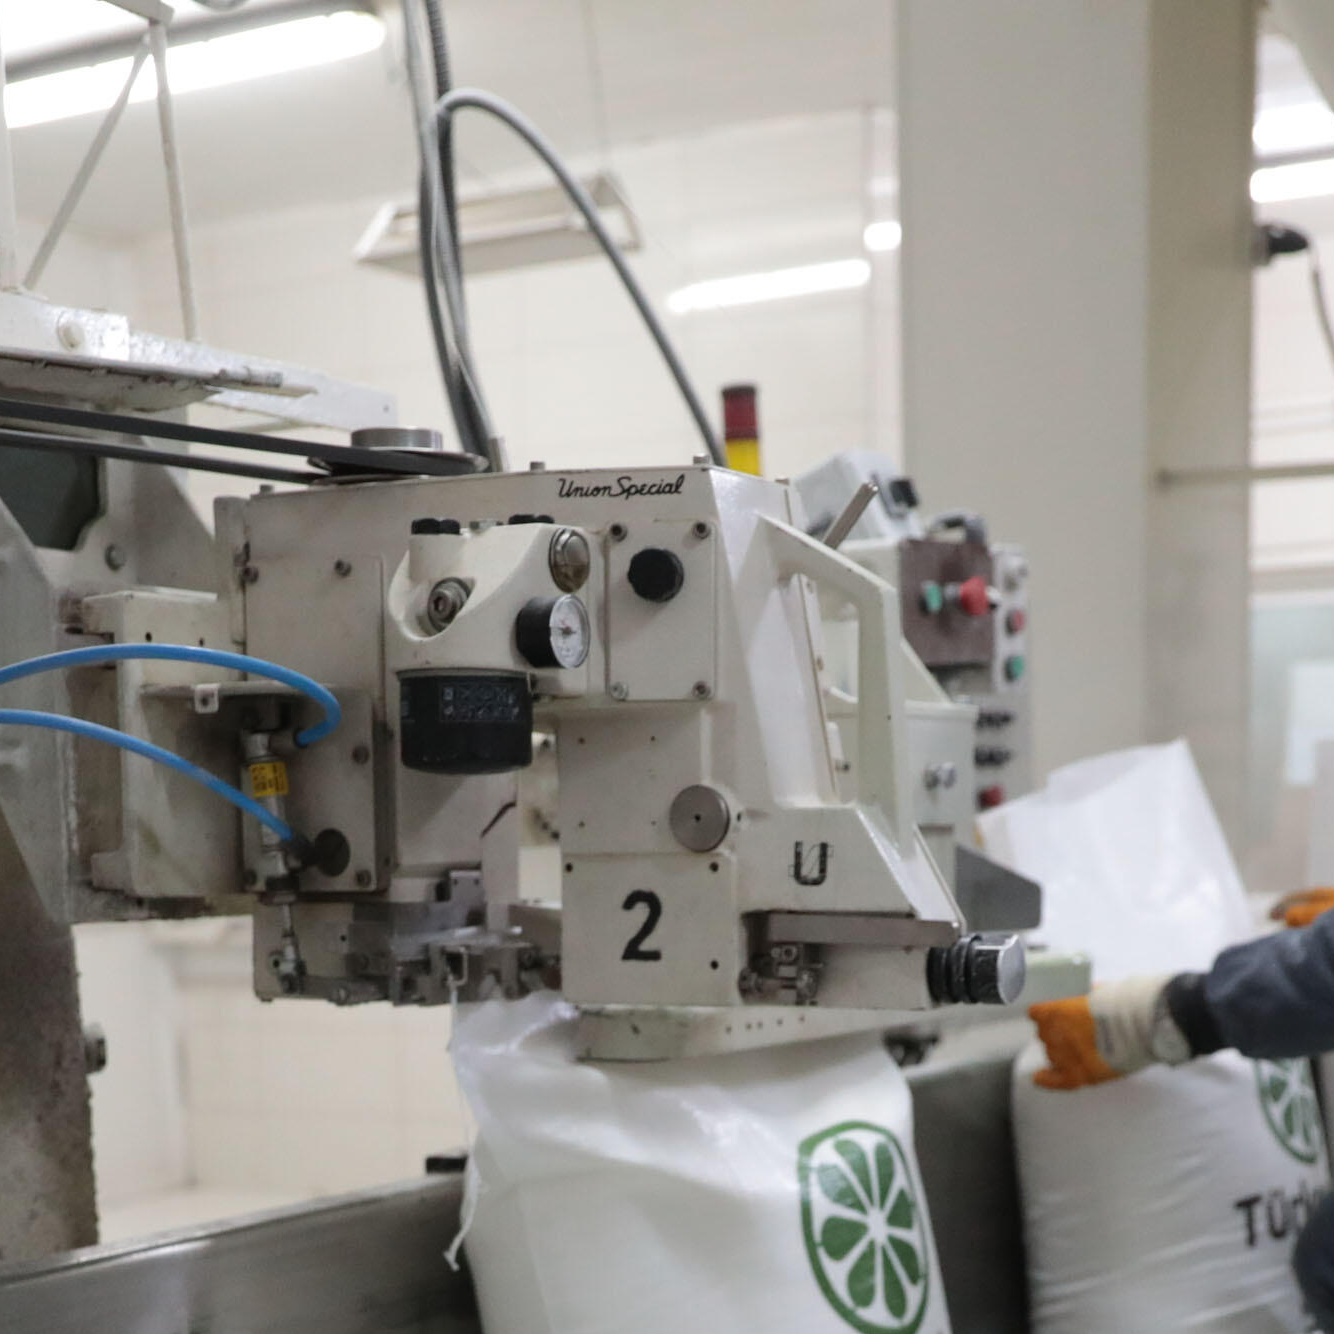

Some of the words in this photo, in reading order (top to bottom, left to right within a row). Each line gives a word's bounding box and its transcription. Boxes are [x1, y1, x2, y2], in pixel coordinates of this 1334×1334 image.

[558, 477, 617, 498] Union
[615, 473, 686, 500] Special
[620, 889, 663, 962] 2
